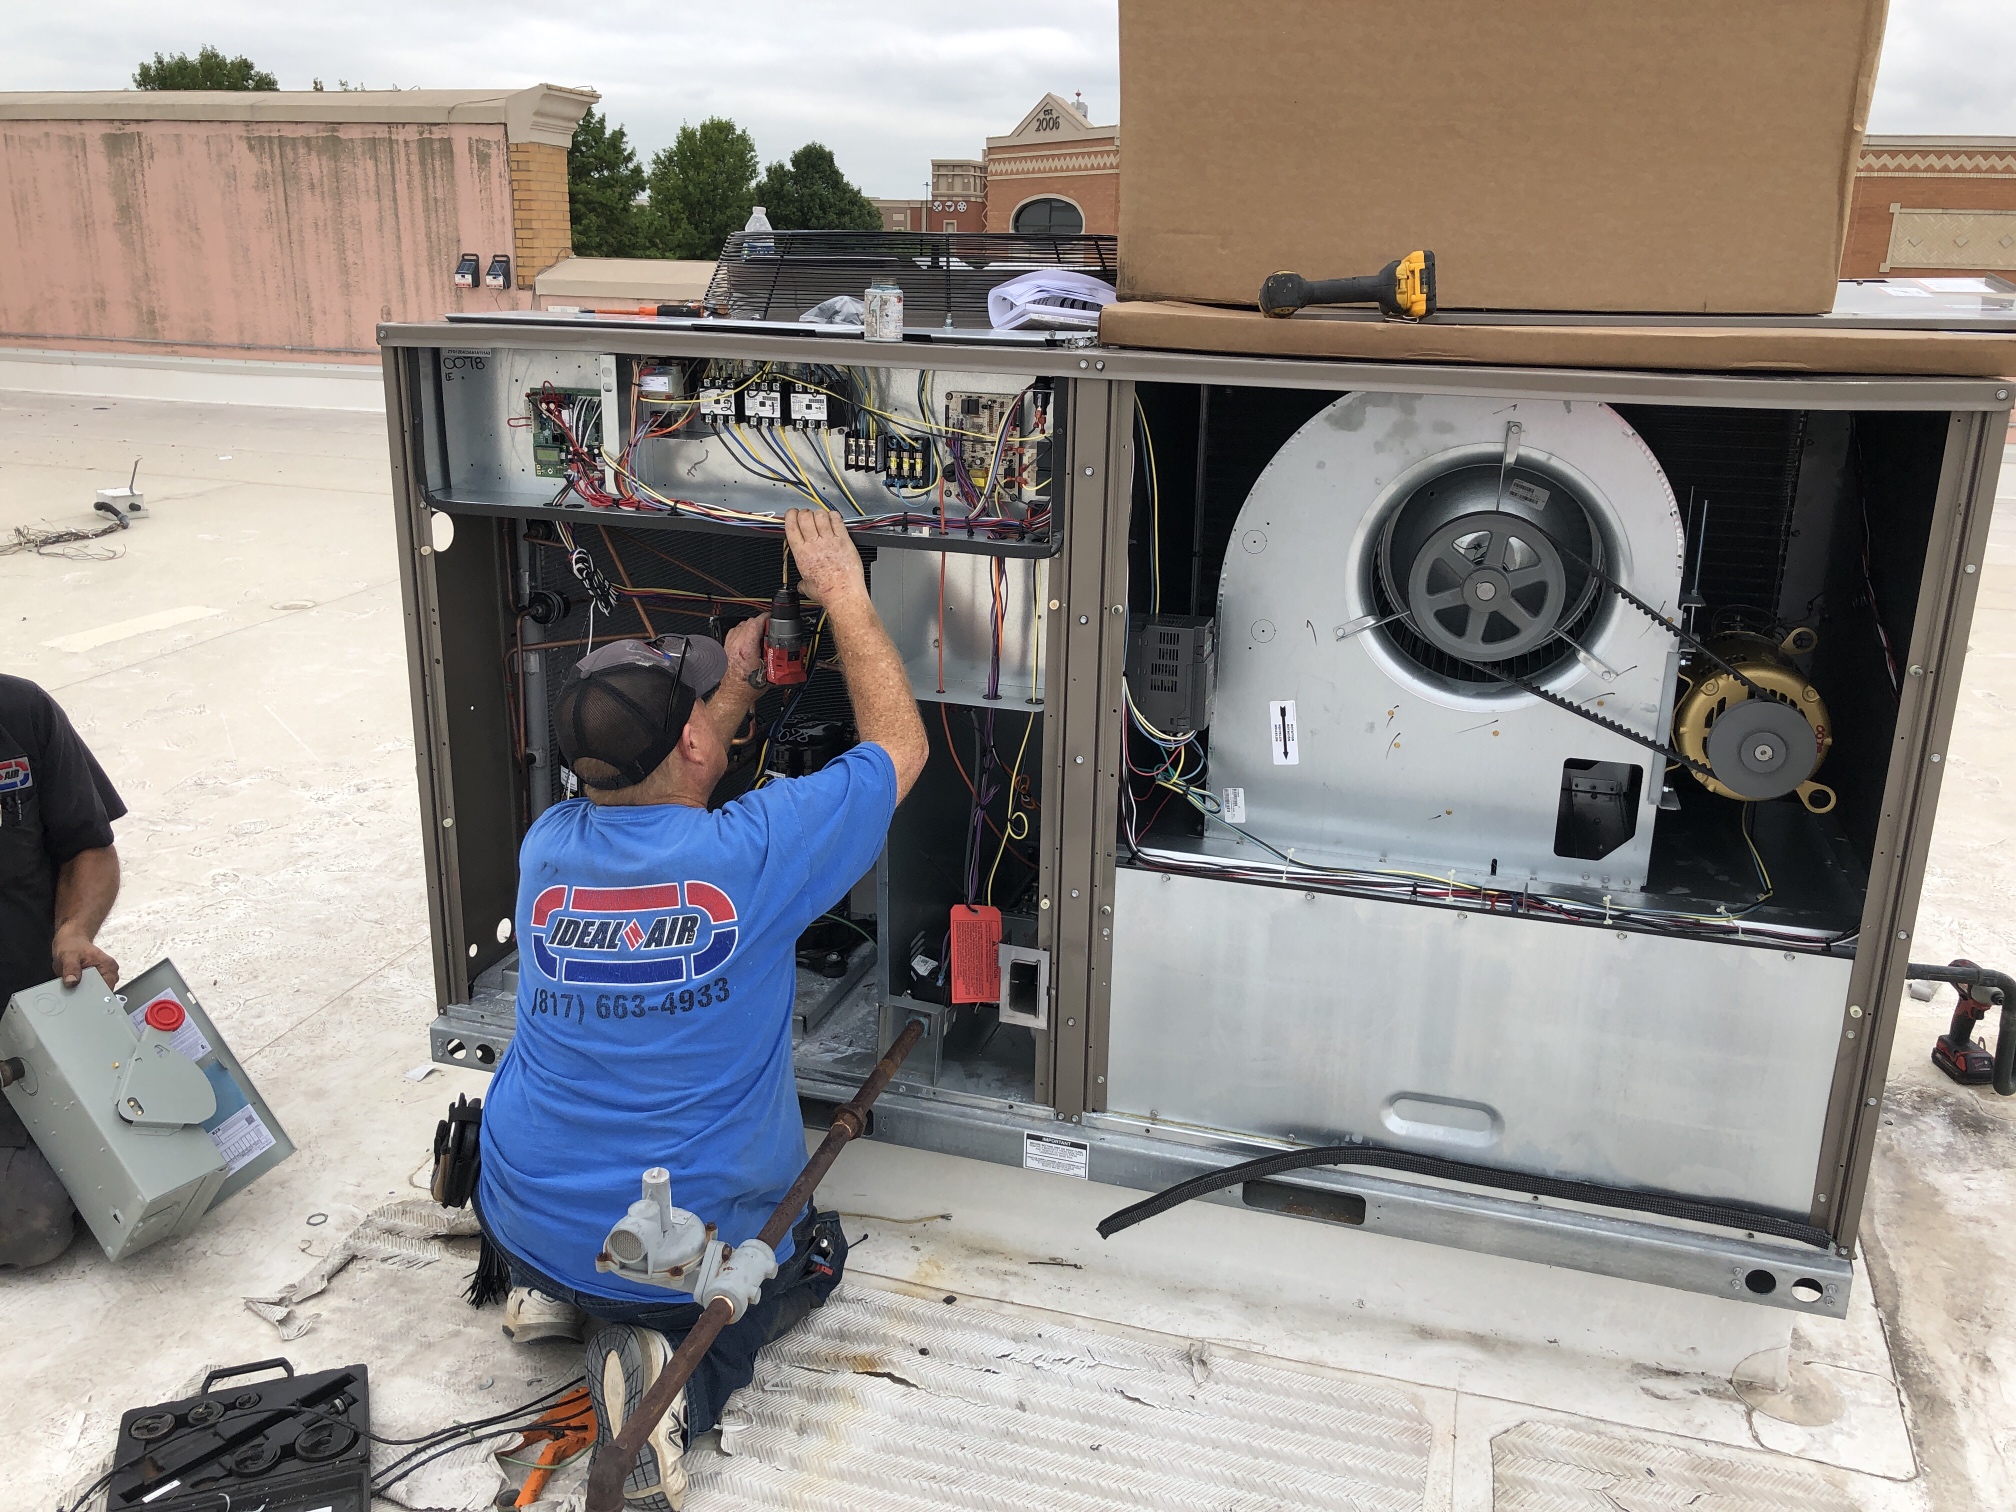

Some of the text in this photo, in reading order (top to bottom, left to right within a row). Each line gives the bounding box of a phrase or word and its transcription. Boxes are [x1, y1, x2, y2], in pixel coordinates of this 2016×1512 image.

[1035, 116, 1060, 132] 2006
[443, 356, 485, 370] 0078
[4, 769, 20, 781] AIR
[548, 917, 625, 950] IDEAL
[623, 918, 645, 951] IN
[641, 914, 700, 950] AIR
[531, 977, 730, 1025] (817) 663-4933
